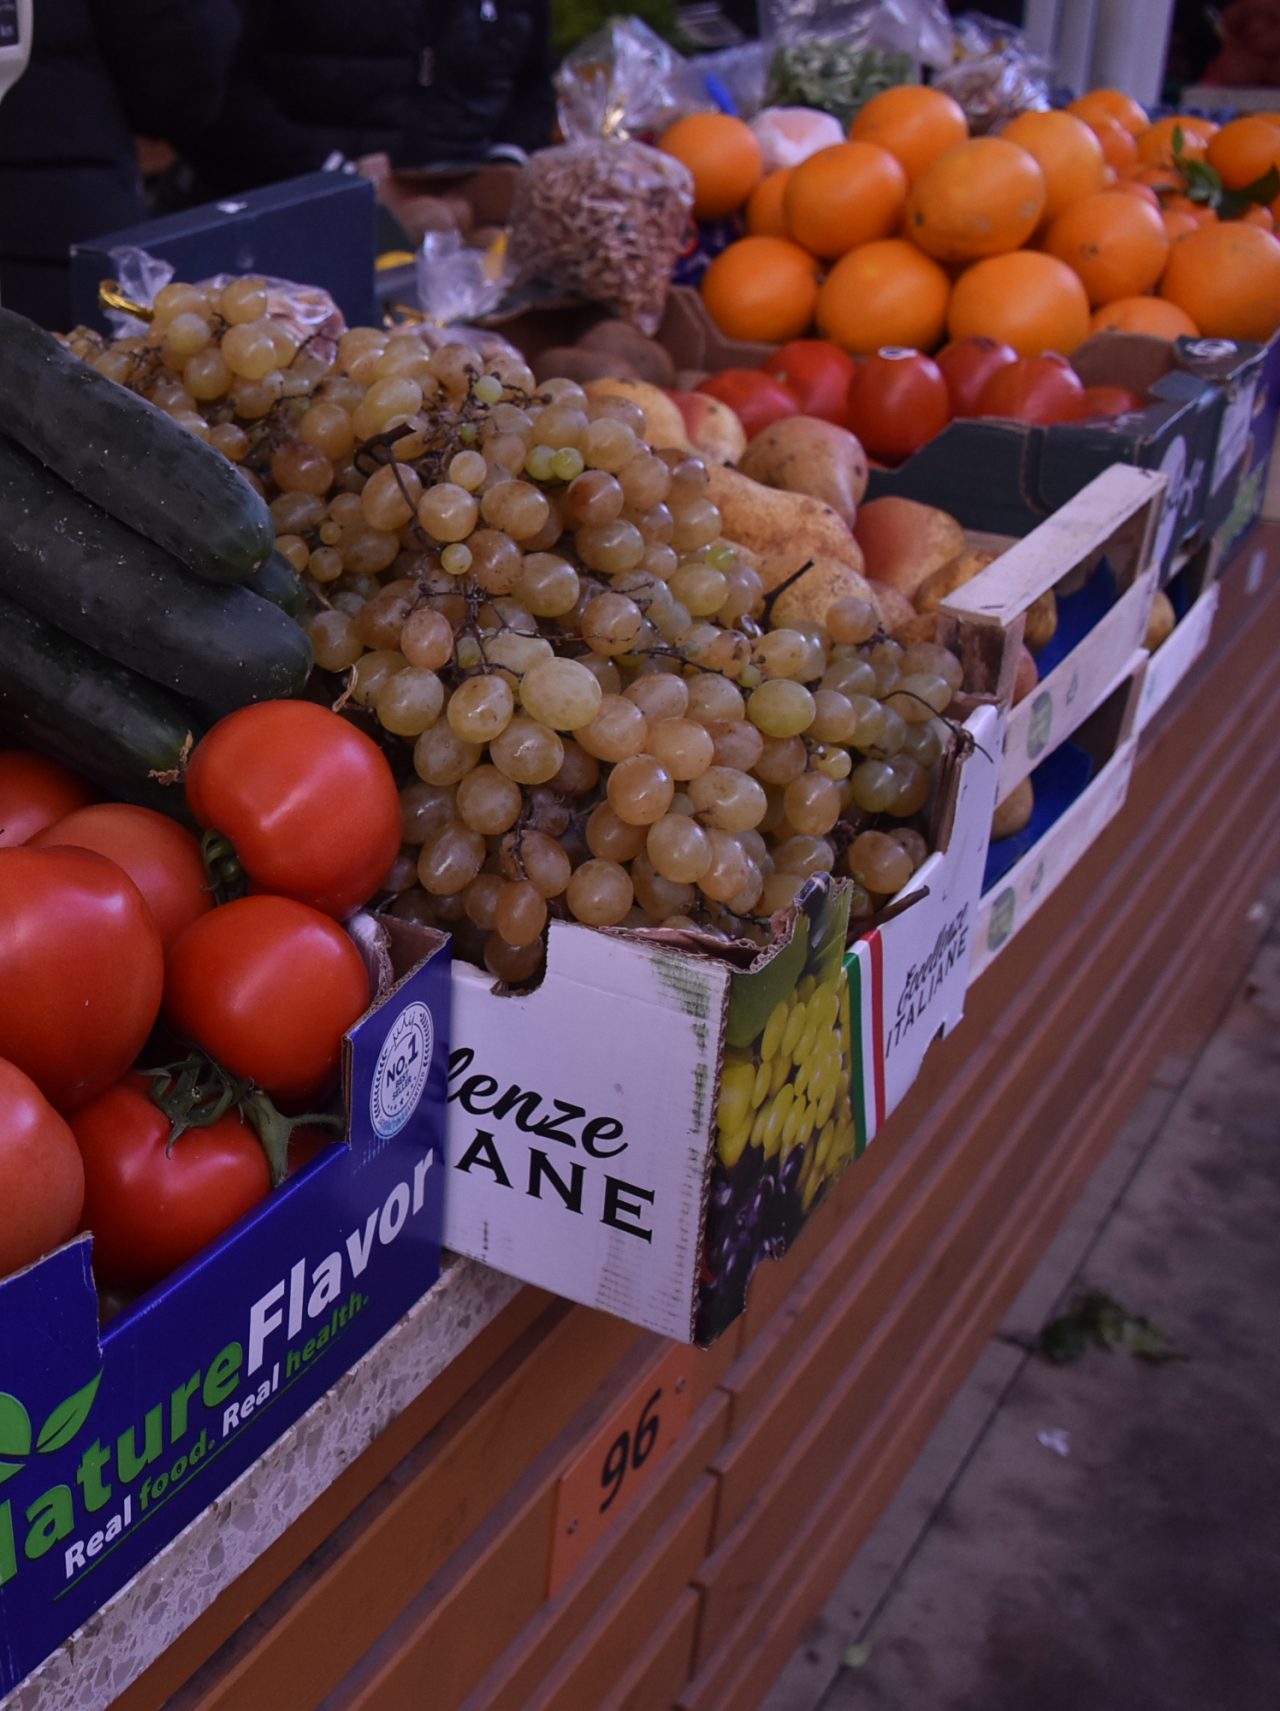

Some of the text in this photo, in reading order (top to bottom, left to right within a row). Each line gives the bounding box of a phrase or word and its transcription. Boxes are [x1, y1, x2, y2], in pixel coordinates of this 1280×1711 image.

[885, 926, 969, 1059] ITALIANE
[454, 1128, 656, 1245] ANE
[65, 1290, 369, 1580] Real food. Real health.
[599, 1388, 662, 1514] 96
